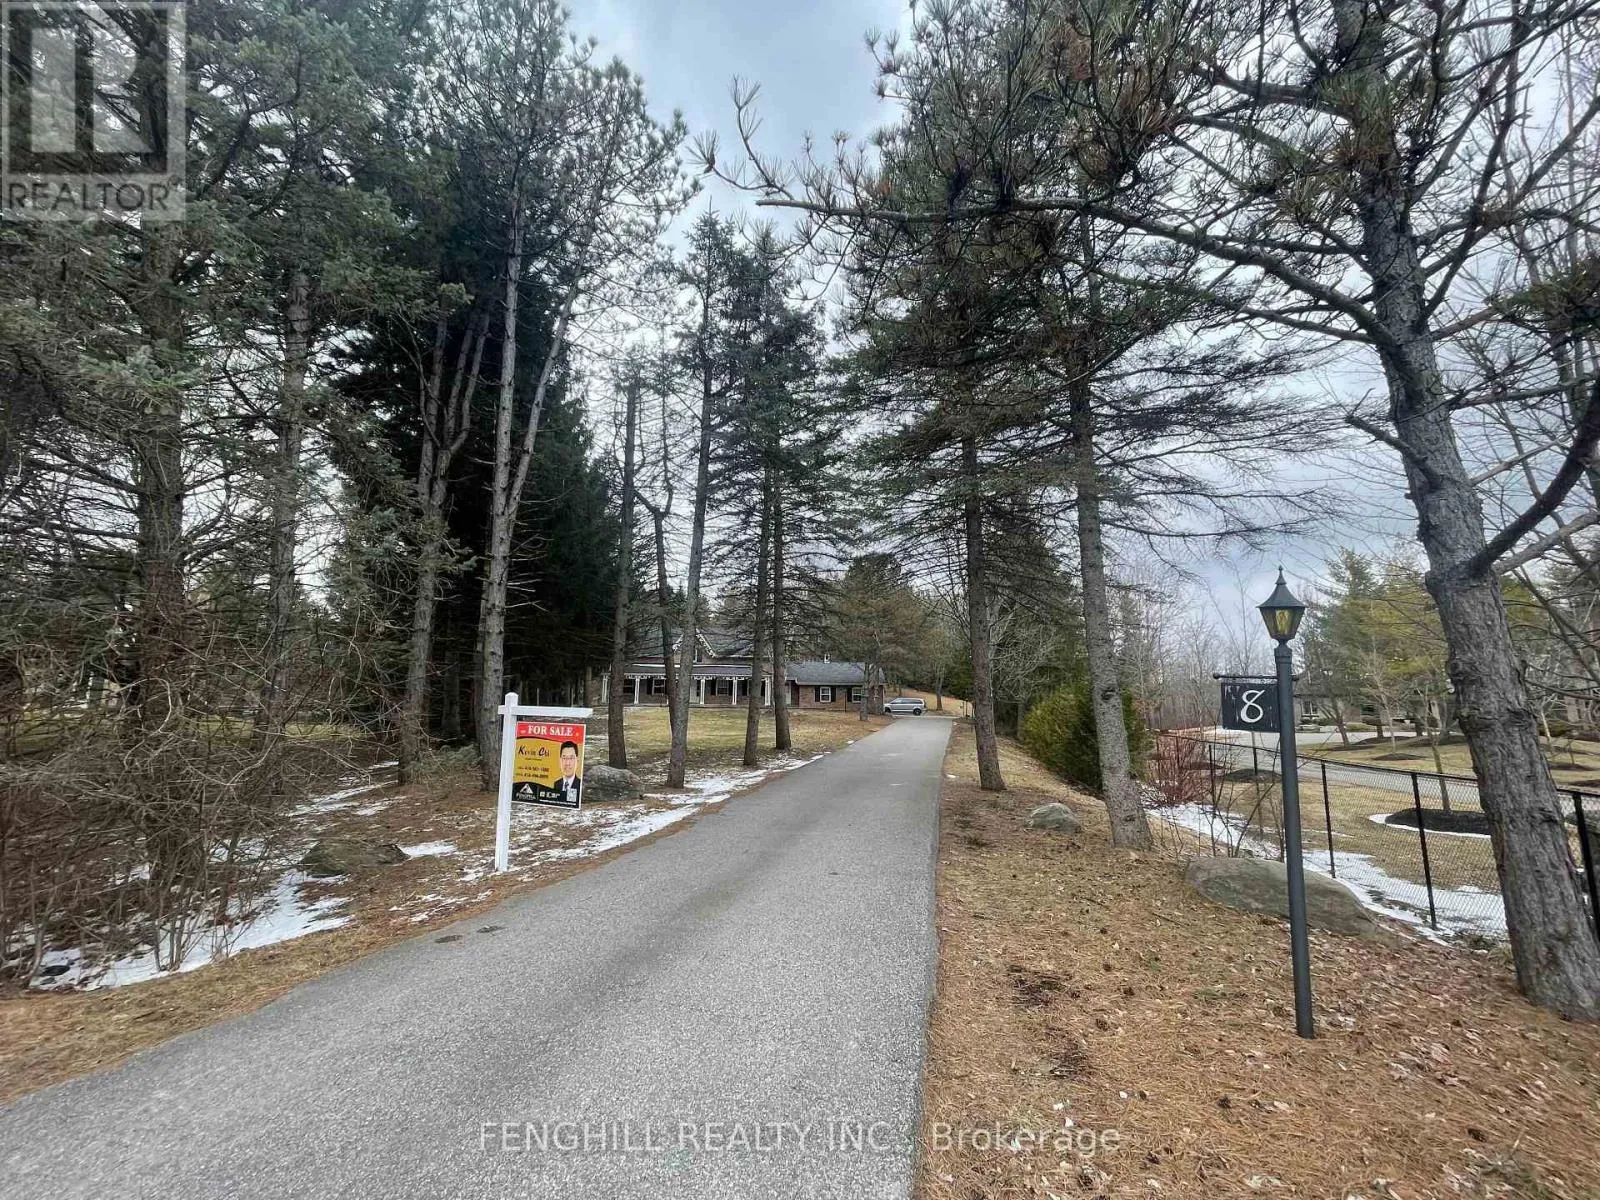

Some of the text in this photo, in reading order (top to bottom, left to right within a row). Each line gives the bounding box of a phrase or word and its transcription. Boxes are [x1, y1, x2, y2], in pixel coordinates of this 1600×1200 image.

[1240, 689, 1265, 723] 8
[527, 725, 574, 736] FOR SALE
